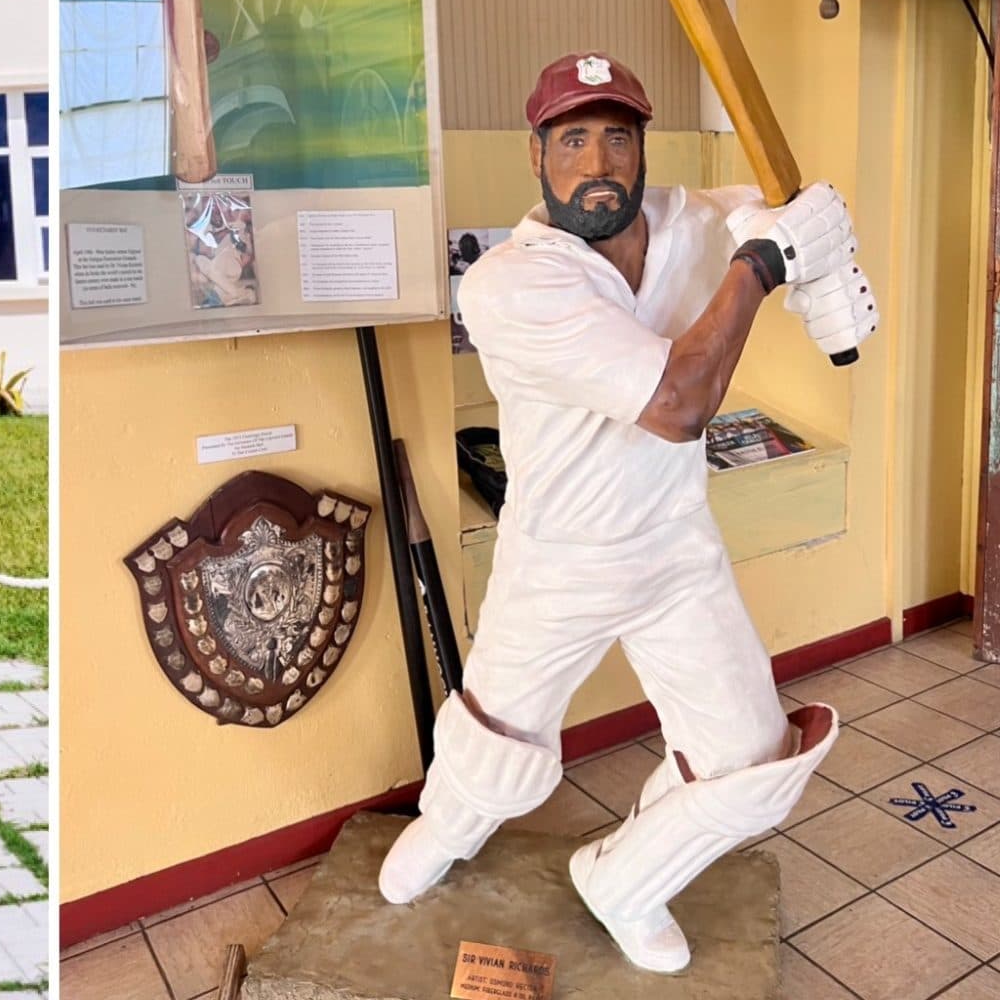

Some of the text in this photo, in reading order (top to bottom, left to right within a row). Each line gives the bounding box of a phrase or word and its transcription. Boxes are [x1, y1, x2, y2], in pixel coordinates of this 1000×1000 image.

[462, 953, 551, 976] SIR VIVIAN RICHARDS
